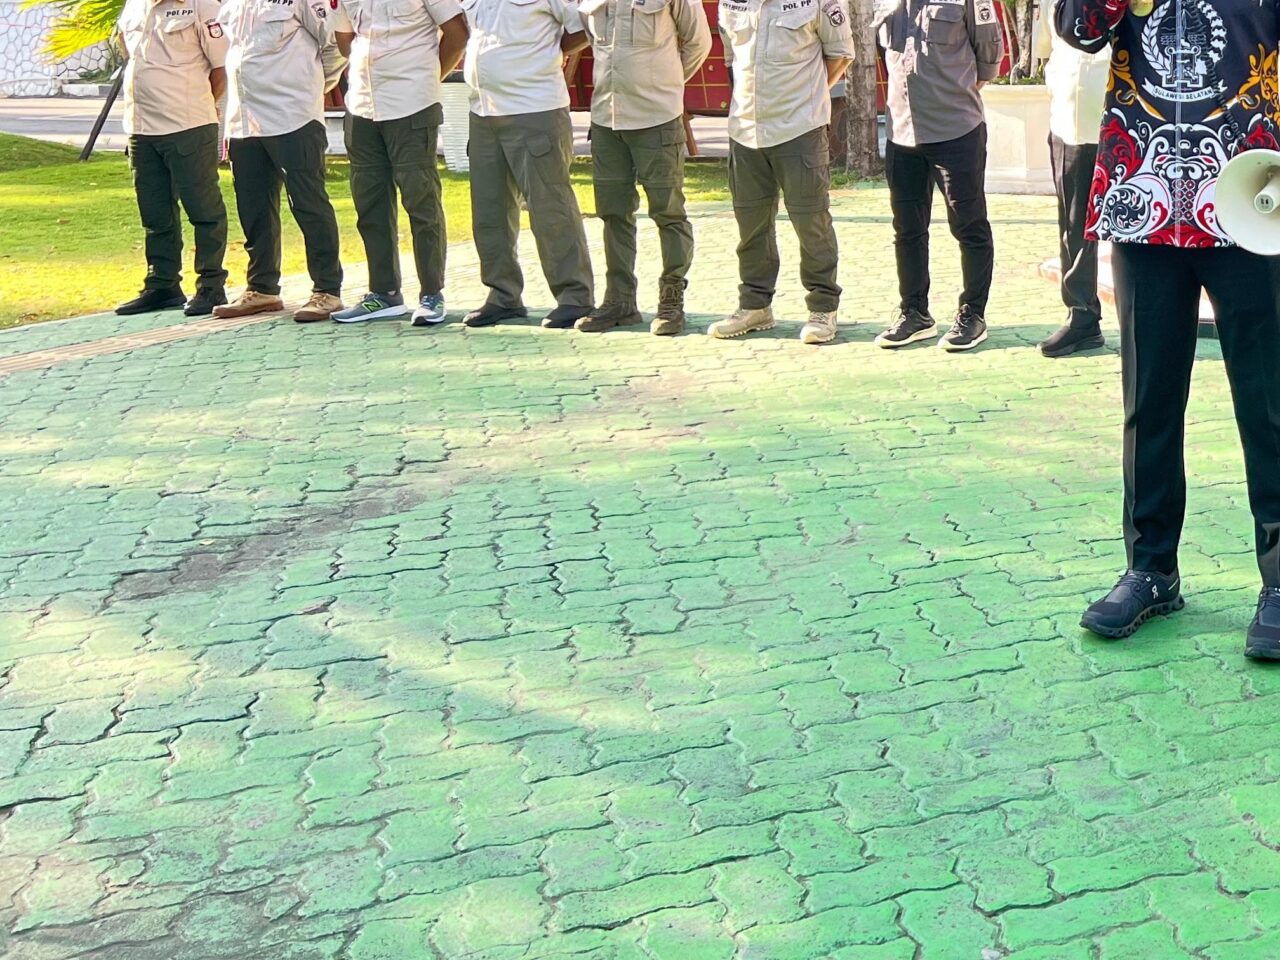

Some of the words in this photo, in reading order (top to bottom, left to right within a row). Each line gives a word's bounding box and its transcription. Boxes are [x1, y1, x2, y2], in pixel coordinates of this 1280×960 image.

[783, 3, 798, 11] POL
[801, 0, 811, 7] PP
[1154, 87, 1185, 100] SULAWESI
[1185, 87, 1213, 100] SELATAN
